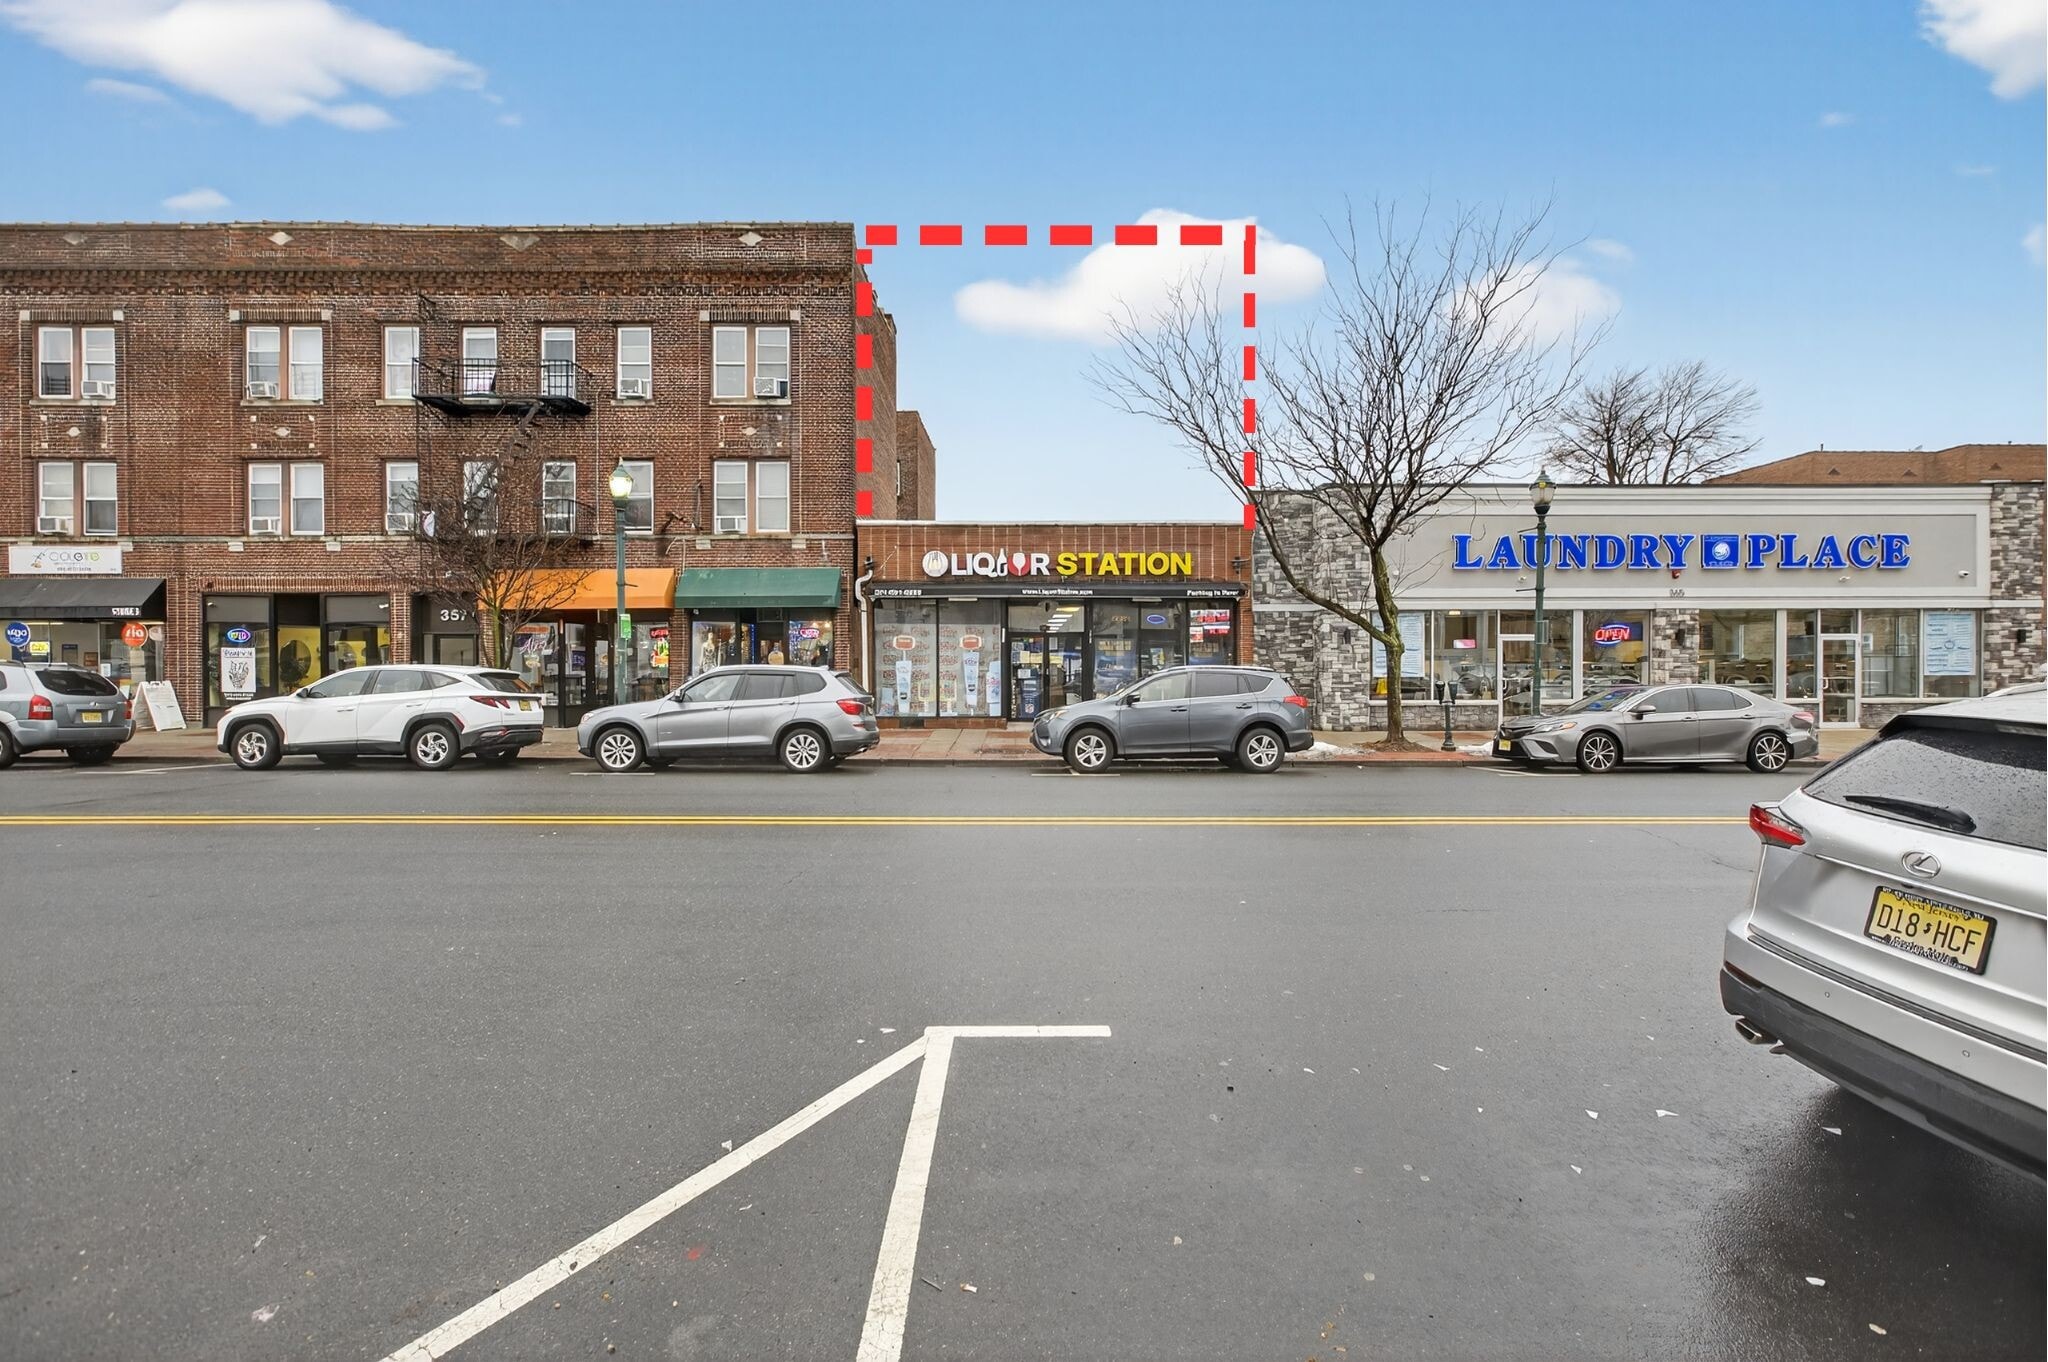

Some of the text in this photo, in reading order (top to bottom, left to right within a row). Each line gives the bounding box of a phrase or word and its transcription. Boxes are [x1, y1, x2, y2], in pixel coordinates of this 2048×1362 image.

[1056, 552, 1193, 577] STATION
[1452, 533, 1912, 570] LAUNDRY PLACE
[1594, 628, 1630, 641] OPEN
[1877, 903, 1982, 956] D18 HCF
